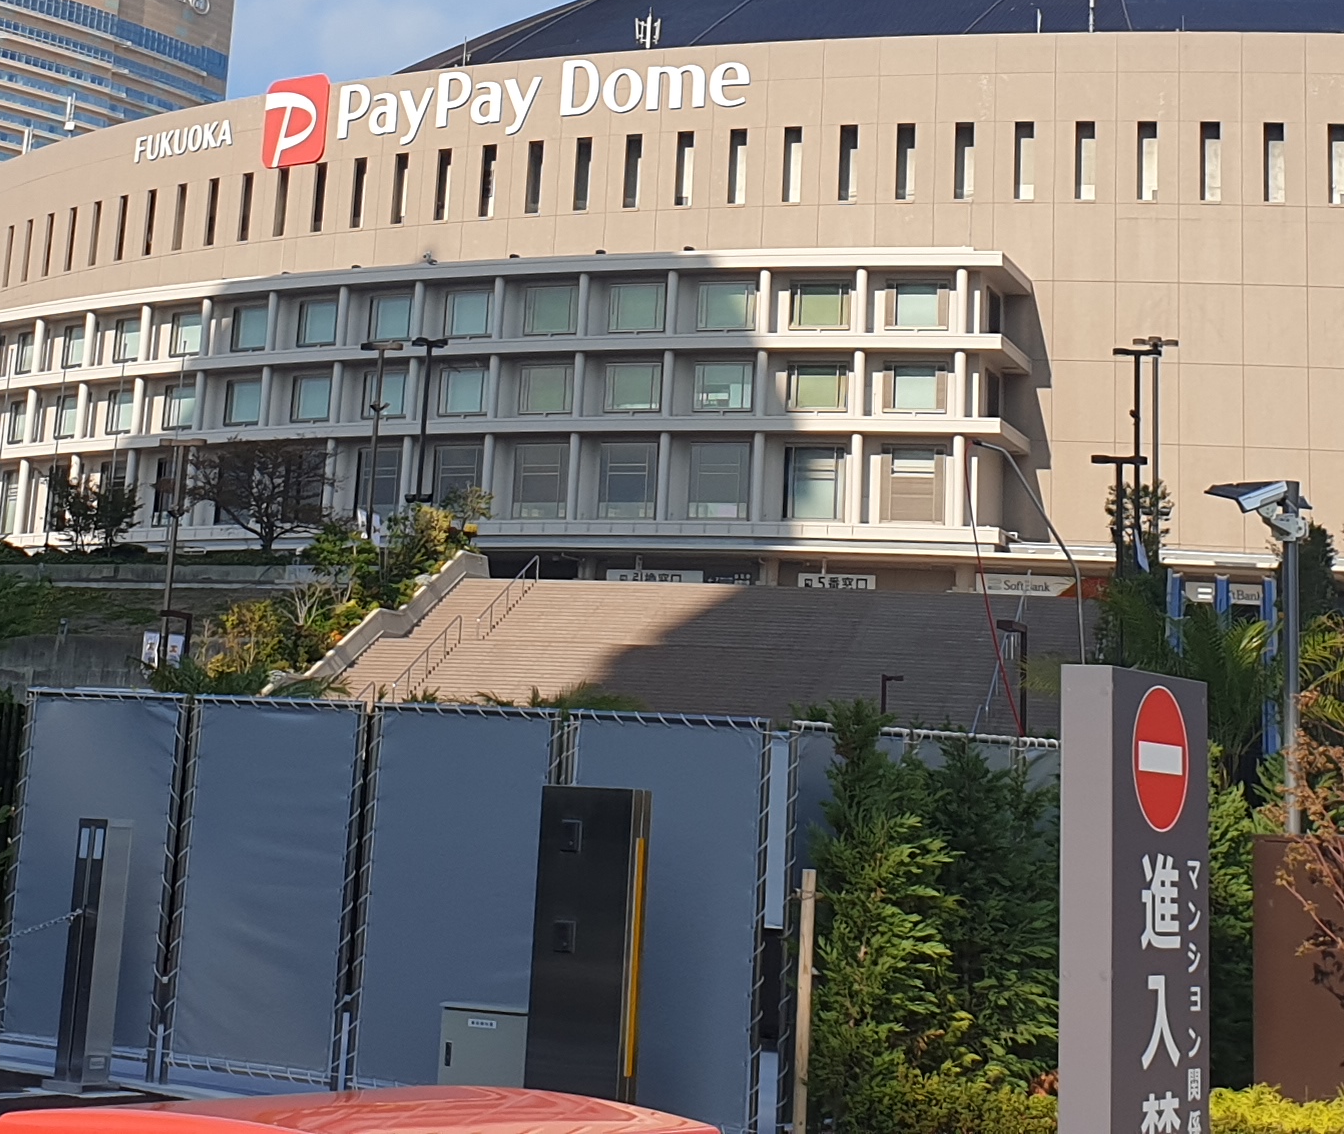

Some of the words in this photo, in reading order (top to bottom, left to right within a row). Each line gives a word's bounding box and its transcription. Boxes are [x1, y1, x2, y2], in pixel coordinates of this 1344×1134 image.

[337, 72, 543, 145] PayPay
[560, 59, 751, 117] Dome
[134, 119, 233, 164] FUKUOKA
